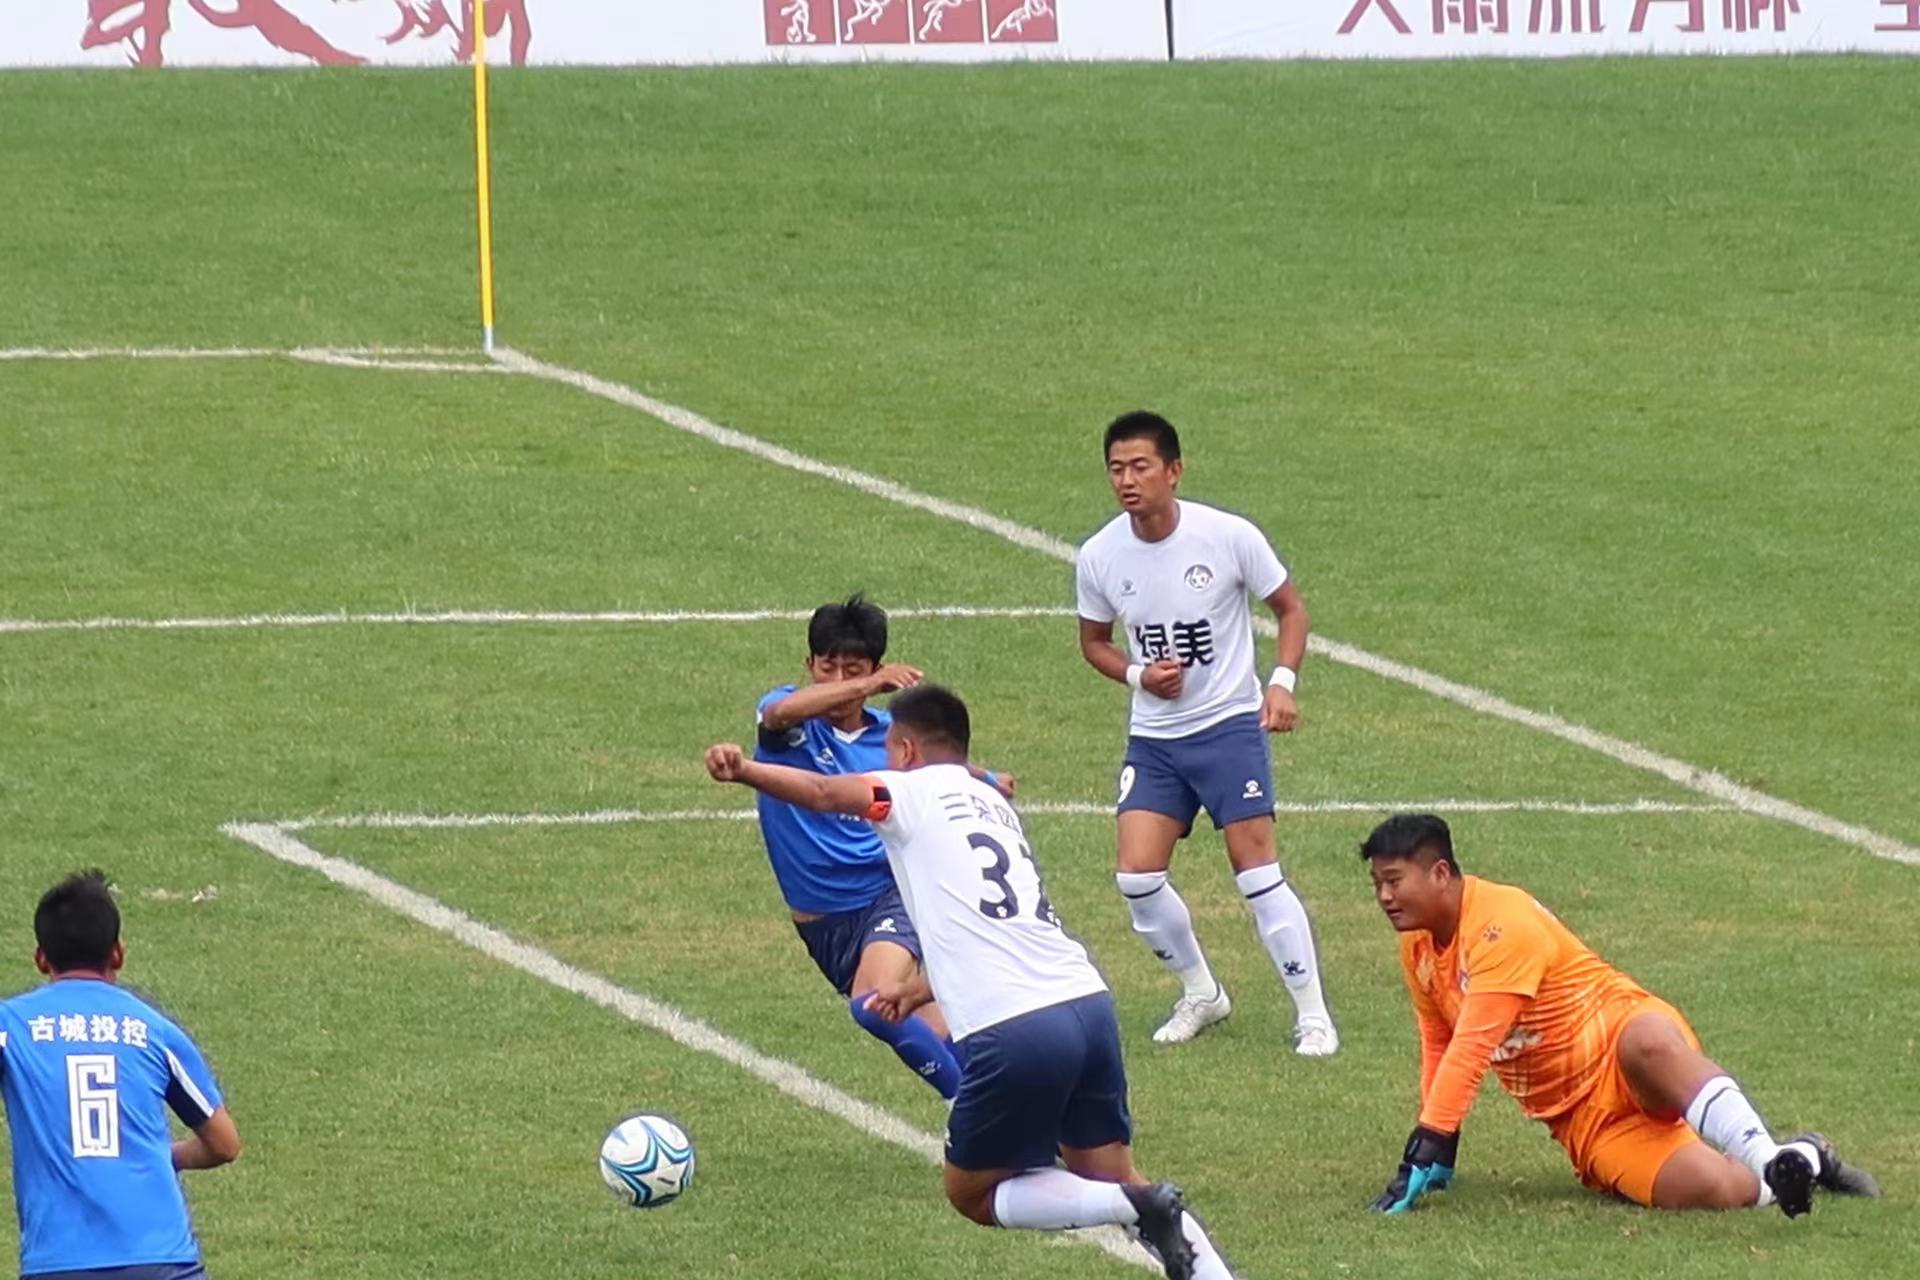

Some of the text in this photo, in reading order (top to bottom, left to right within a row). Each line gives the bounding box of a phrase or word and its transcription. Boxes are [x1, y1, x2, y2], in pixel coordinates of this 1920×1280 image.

[1133, 618, 1214, 668] 绿美
[27, 1013, 147, 1048] 古城投控
[65, 1054, 119, 1158] 6
